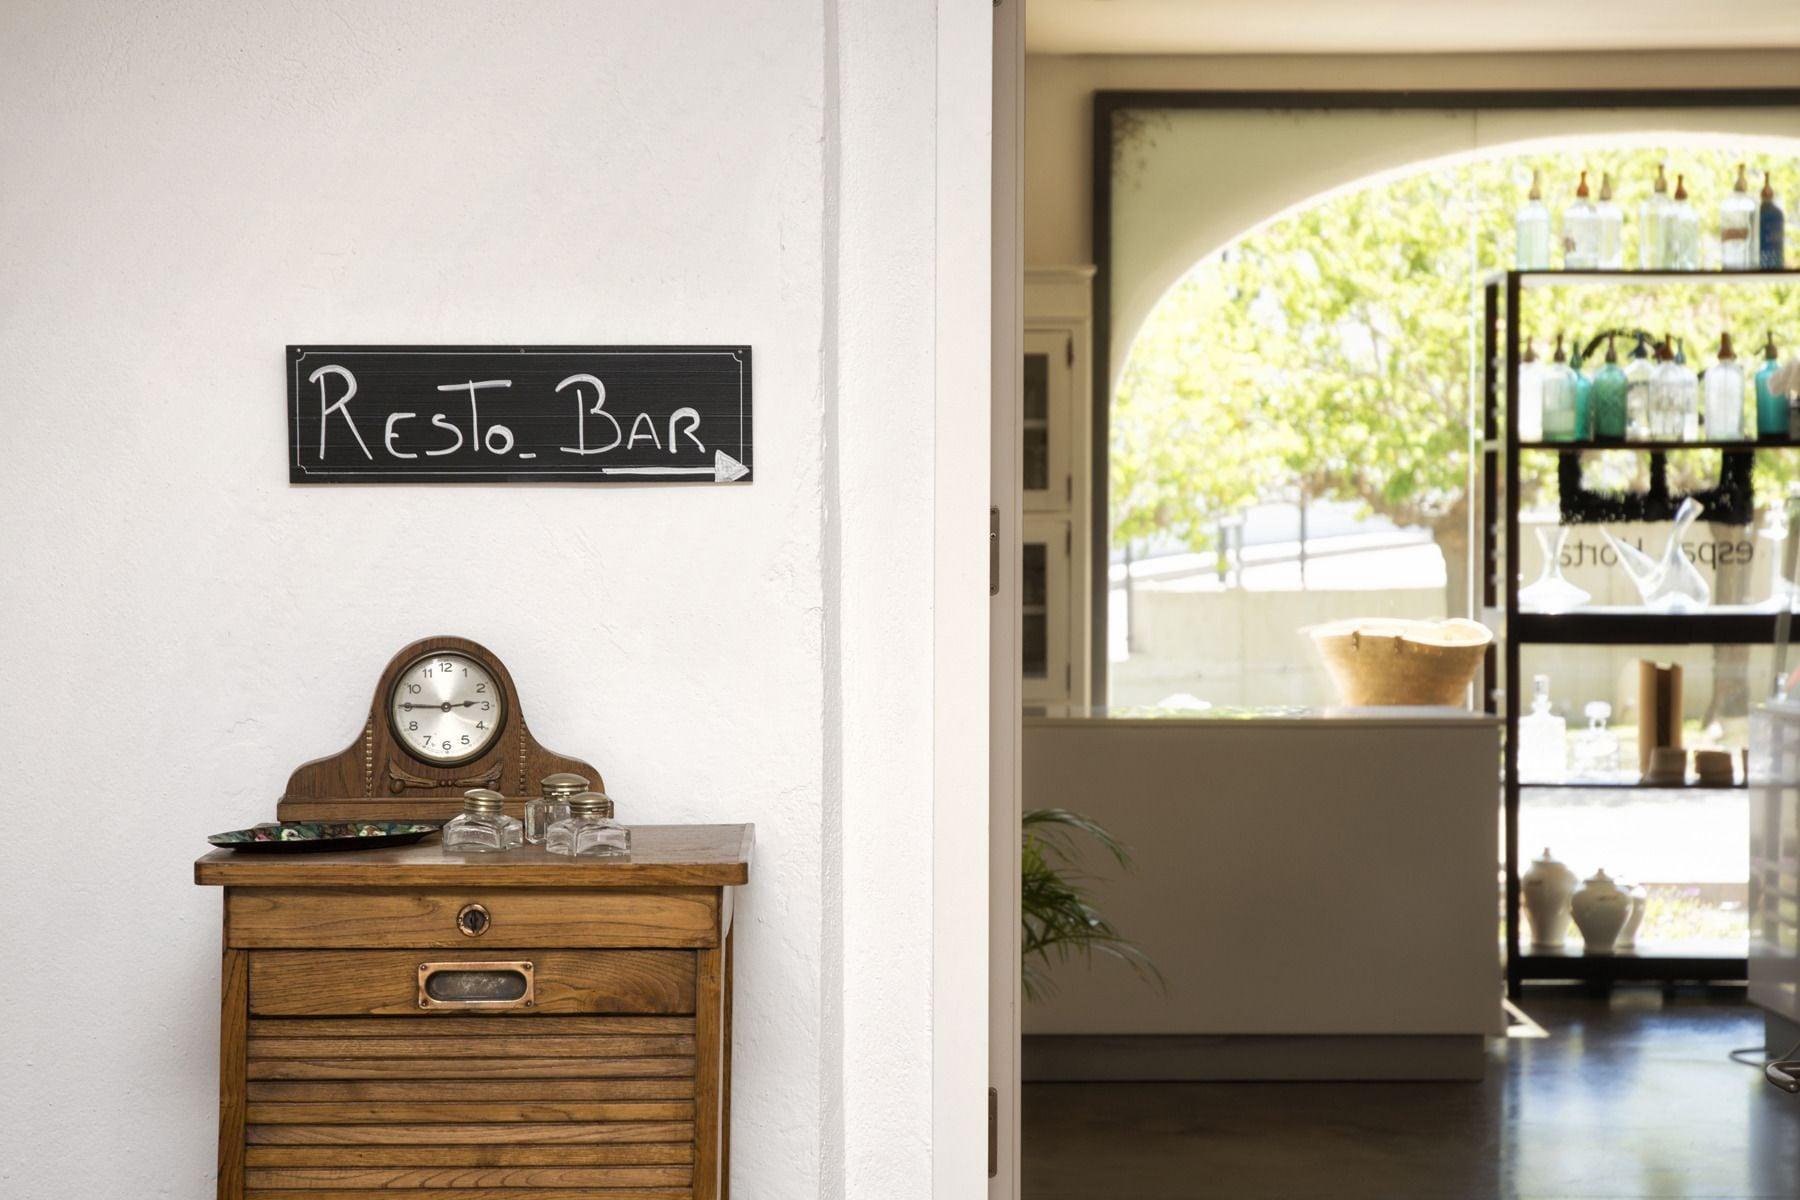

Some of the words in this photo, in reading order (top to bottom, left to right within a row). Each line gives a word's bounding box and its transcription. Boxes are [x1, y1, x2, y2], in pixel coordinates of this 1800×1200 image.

[555, 373, 706, 456] BAR
[439, 662, 453, 673] 12
[423, 668, 433, 678] 11
[462, 668, 468, 678] 1
[408, 684, 422, 694] 10
[476, 683, 486, 693] 2
[403, 702, 413, 712] 9
[481, 701, 490, 711] 3
[409, 721, 418, 731] 8
[476, 721, 485, 730] 4
[423, 735, 432, 745] 7
[461, 735, 470, 745] 5
[442, 741, 452, 751] 6
